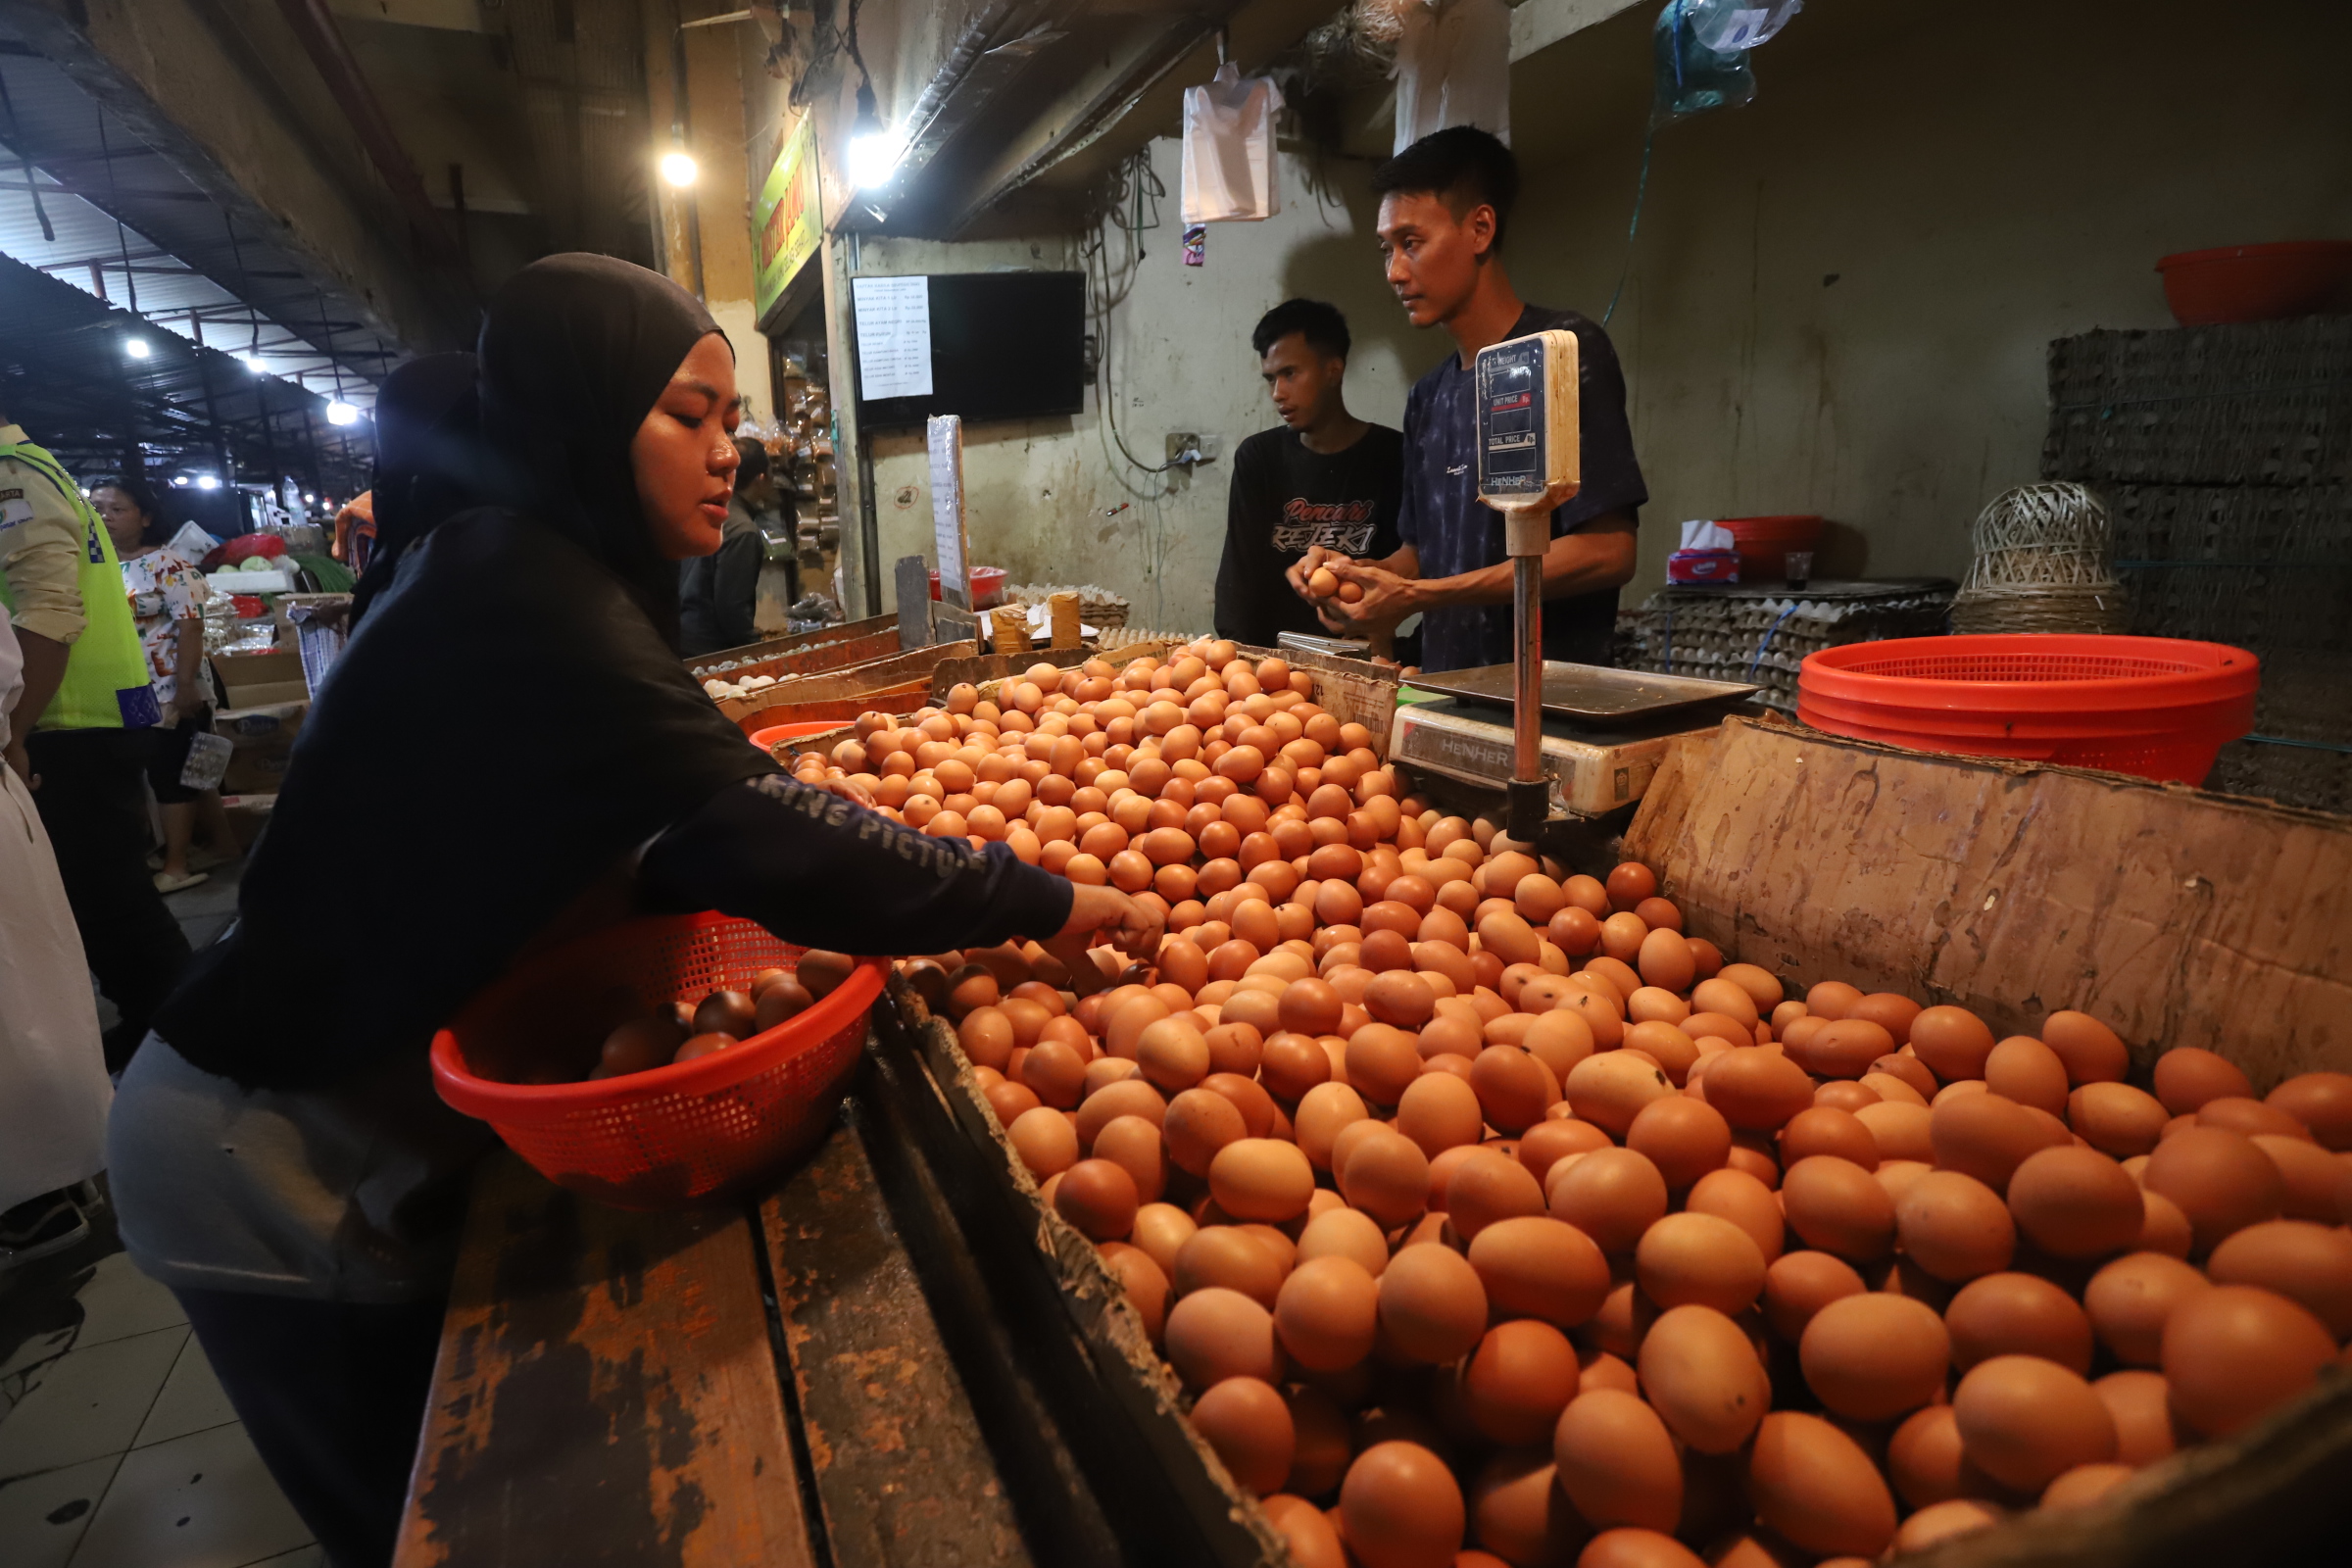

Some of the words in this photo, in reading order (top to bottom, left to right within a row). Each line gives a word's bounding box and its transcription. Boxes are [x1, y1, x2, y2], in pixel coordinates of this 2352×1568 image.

[1493, 397, 1504, 407] UNIT
[1504, 395, 1518, 405] PRICE
[1489, 436, 1503, 446] TOTAL
[1505, 434, 1521, 444] PRICE
[1284, 498, 1375, 526] Pencari
[1442, 738, 1509, 767] HENHER
